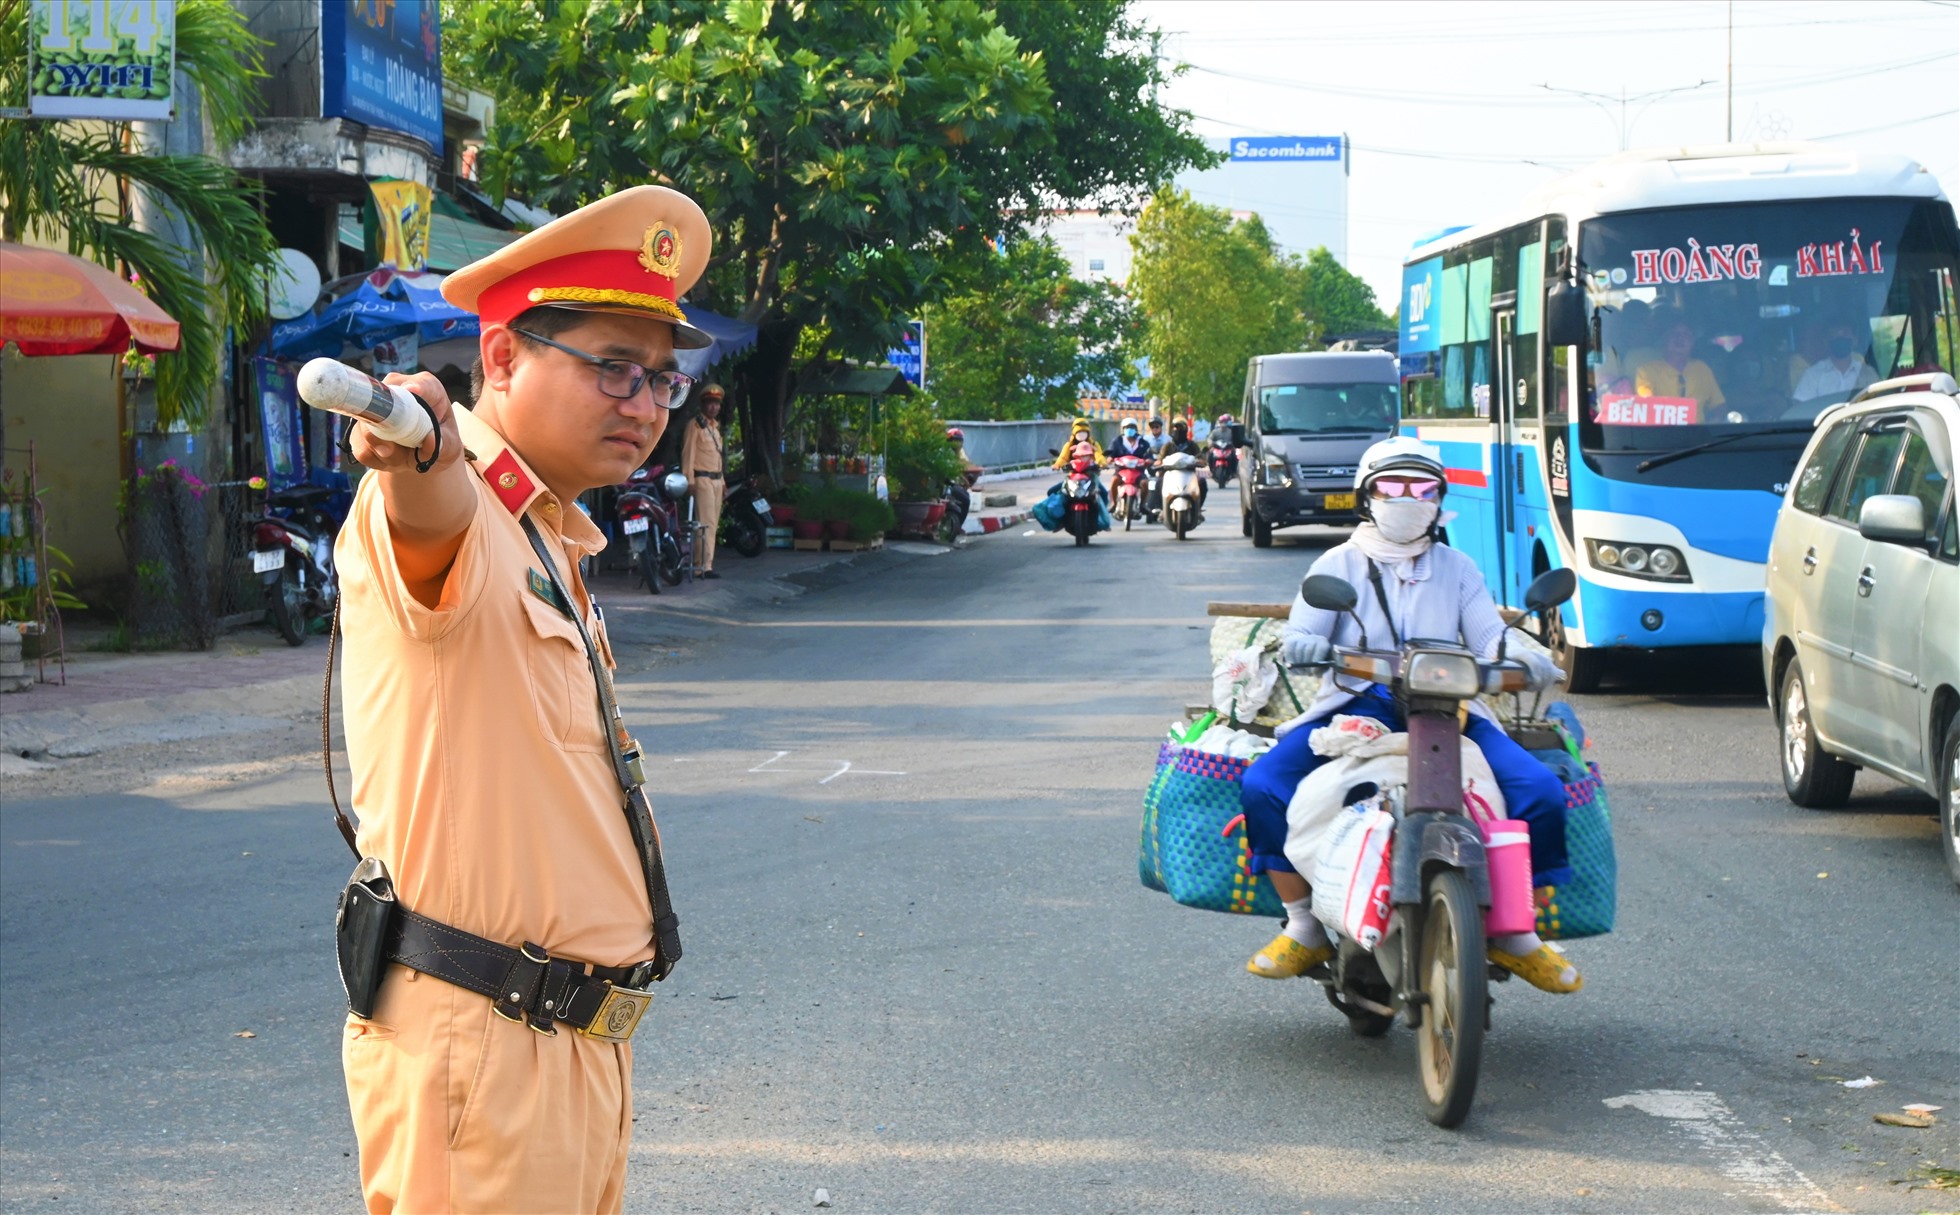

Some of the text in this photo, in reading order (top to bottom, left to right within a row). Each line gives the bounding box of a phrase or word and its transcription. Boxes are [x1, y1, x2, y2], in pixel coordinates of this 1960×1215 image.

[40, 0, 162, 55] 114
[47, 63, 154, 89] WIFI
[386, 54, 418, 113] HOÀNG
[1235, 141, 1336, 158] Sacombank
[1633, 228, 1884, 285] HOÀNG KHẢI
[1653, 404, 1689, 425] TRE
